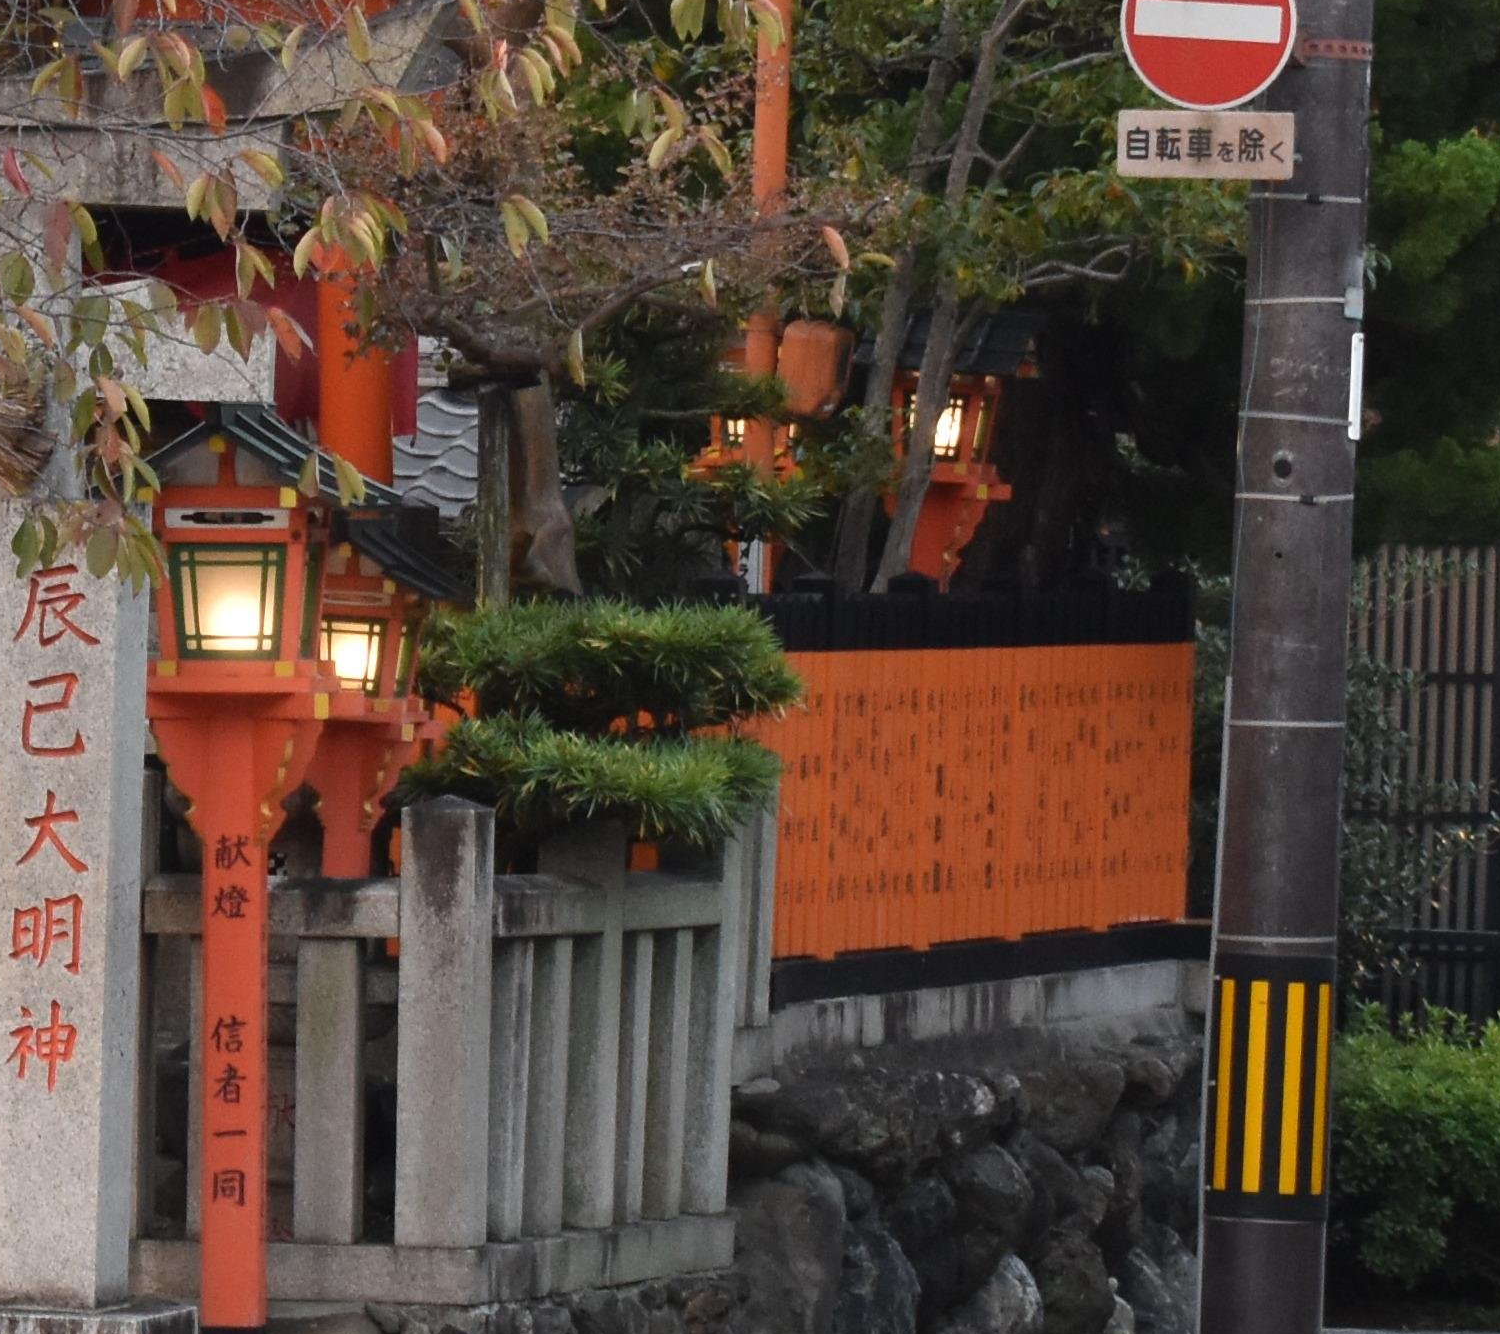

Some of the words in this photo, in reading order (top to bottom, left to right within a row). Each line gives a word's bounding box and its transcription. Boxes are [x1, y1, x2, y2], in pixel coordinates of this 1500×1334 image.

[1125, 126, 1286, 164] 自転車を除く
[211, 833, 251, 919] 献燈
[210, 1015, 248, 1207] 信者一同
